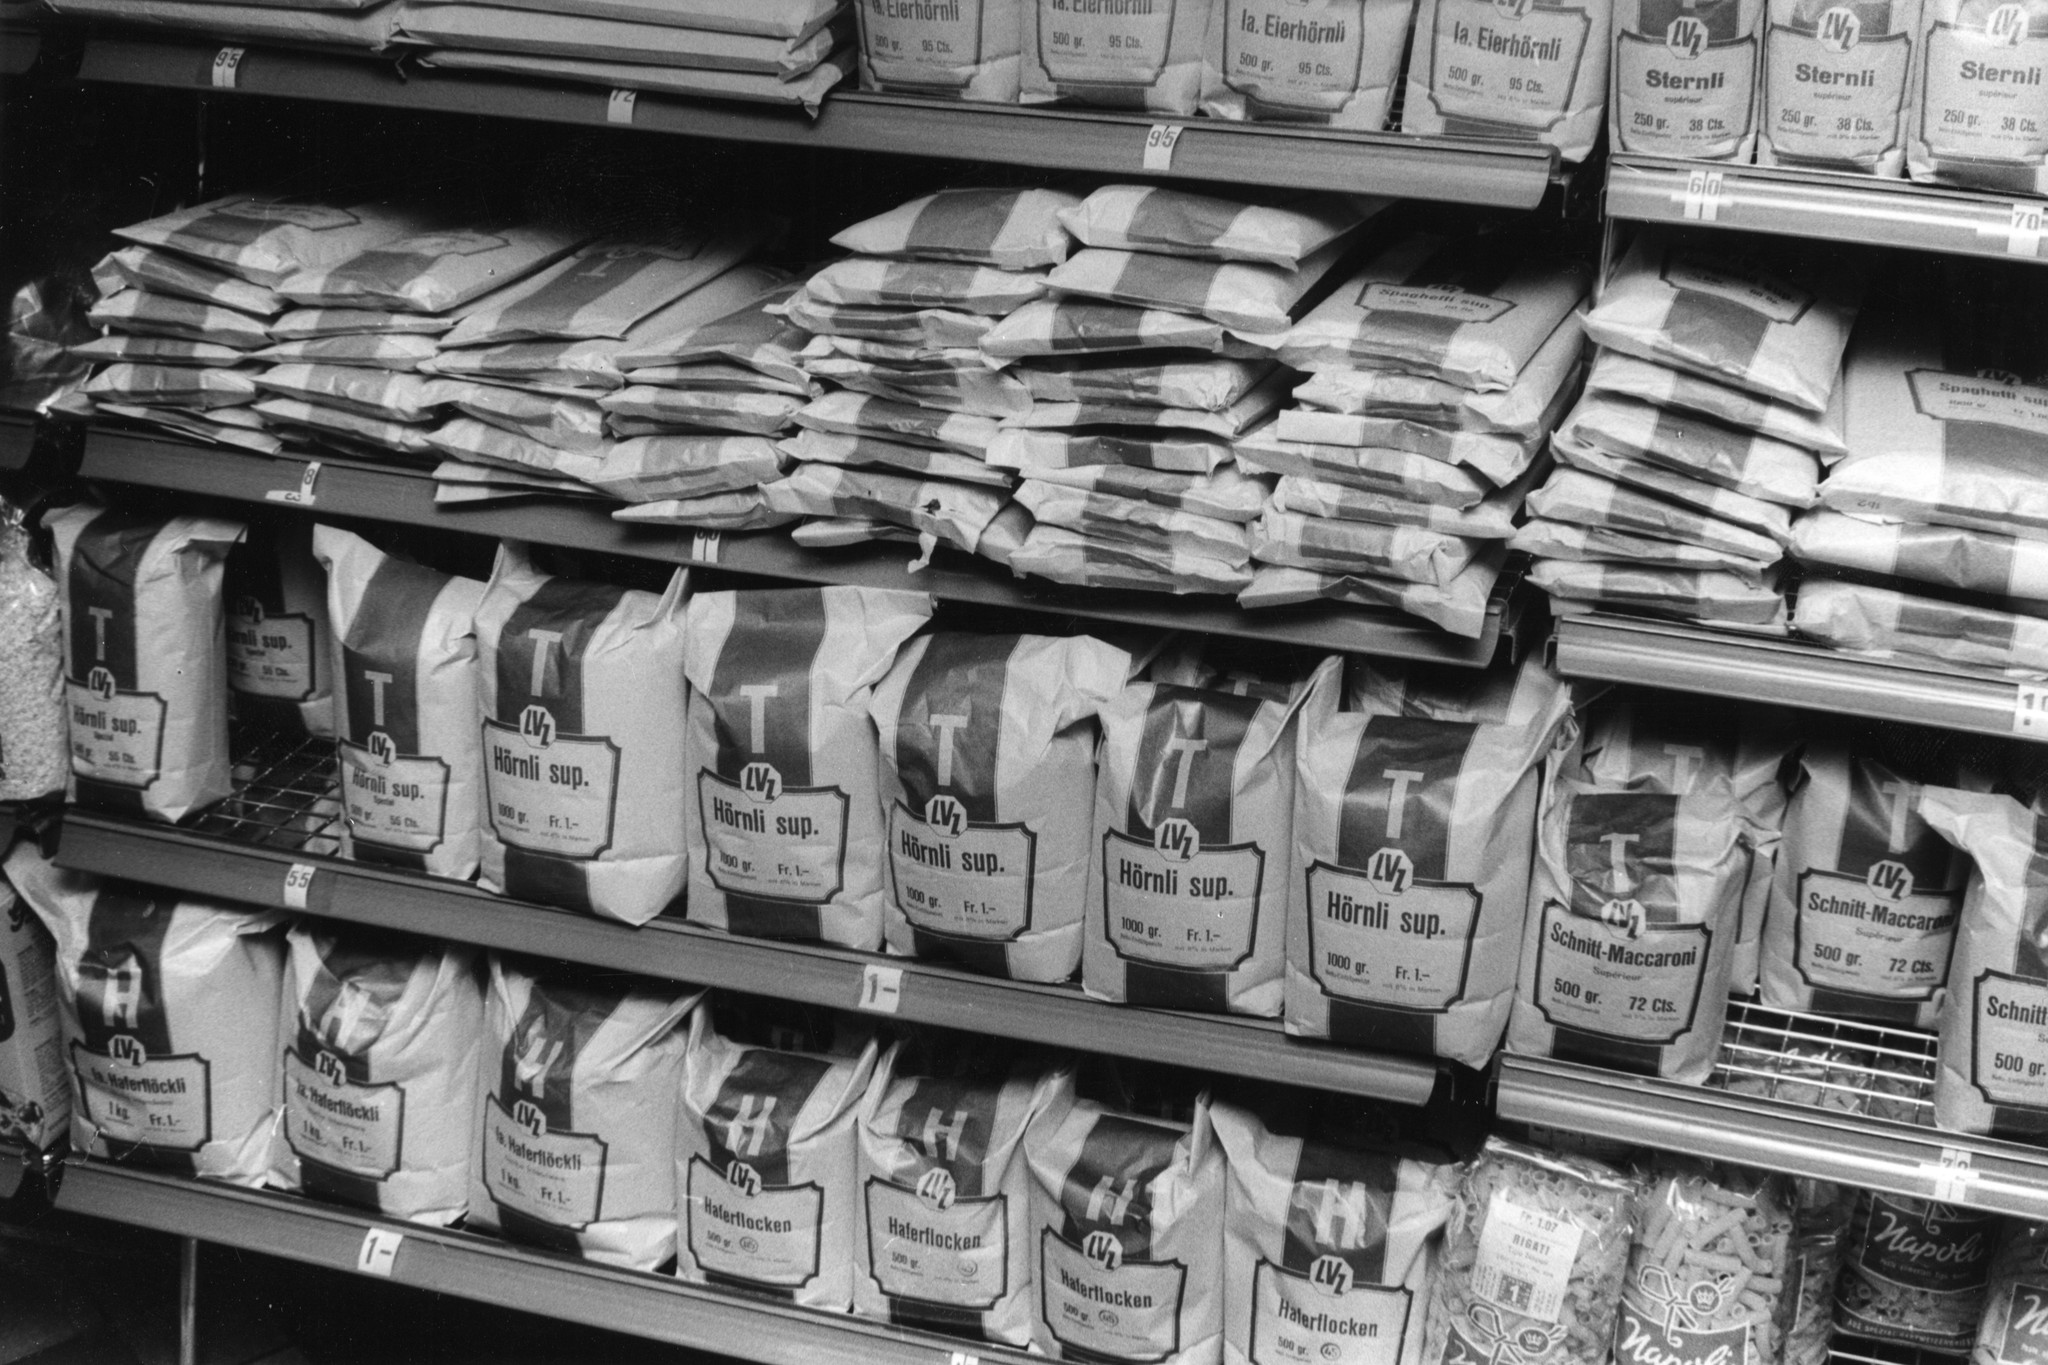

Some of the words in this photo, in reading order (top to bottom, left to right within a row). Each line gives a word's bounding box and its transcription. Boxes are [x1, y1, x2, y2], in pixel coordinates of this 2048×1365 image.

[922, 39, 933, 52] 95
[1053, 32, 1069, 45] 500
[1109, 35, 1121, 48] 95
[1125, 35, 1142, 48] Cts.
[1264, 14, 1346, 44] Eierhörnli
[1477, 26, 1562, 62] Eierhörnli
[215, 51, 240, 68] 95
[1240, 52, 1258, 68] 500
[1261, 57, 1274, 72] gr.
[1298, 61, 1312, 75] 95
[1315, 62, 1332, 77] Cts.
[1794, 62, 1875, 87] Sternli
[1959, 60, 2041, 86] Sternli
[1448, 66, 1468, 82] 500
[1470, 72, 1484, 87] gr.
[1508, 77, 1523, 91] 95
[1526, 78, 1544, 94] Cts.
[1645, 69, 1724, 90] Sternli
[1633, 111, 1653, 127] 250
[1656, 117, 1670, 132] gr.
[1689, 117, 1704, 133] 38
[1707, 117, 1725, 132] Cts.
[1781, 108, 1801, 124] 250
[1803, 112, 1817, 127] gr.
[1836, 116, 1852, 132] 38
[1855, 116, 1874, 132] Cts.
[1944, 108, 1964, 124] 250
[1966, 113, 1981, 127] gr.
[2001, 116, 2016, 132] 38
[2019, 116, 2038, 133] Cts.
[1149, 130, 1177, 148] 95
[1689, 176, 1719, 196] 60
[2014, 211, 2039, 230] 70
[1379, 288, 1456, 302] Spaghetti
[1939, 382, 2016, 400] Spaghetti
[88, 606, 113, 660] T
[262, 634, 292, 651] sup.
[528, 628, 563, 697] T
[364, 670, 393, 726] T
[73, 703, 106, 730] Hörnli
[111, 718, 142, 735] sup.
[524, 709, 550, 747] LVZ
[739, 685, 778, 754] T
[371, 734, 391, 766] LVZ
[929, 713, 968, 786] T
[494, 745, 540, 781] Hörnli
[550, 763, 590, 788] sup.
[1166, 738, 1208, 809] T
[352, 767, 386, 795] Hörnli
[392, 782, 424, 800] sup.
[745, 766, 776, 801] LVZ
[517, 810, 529, 825] gr.
[549, 815, 562, 829] Fr.
[713, 796, 765, 833] Hörnli
[777, 814, 819, 840] sup.
[931, 799, 961, 836] LVZ
[1382, 769, 1424, 839] T
[1882, 781, 1919, 852] T
[901, 829, 951, 869] Hörnli
[961, 848, 1005, 877] sup.
[1160, 823, 1193, 860] LVZ
[287, 870, 311, 888] 55
[719, 852, 738, 868] 1000
[741, 859, 755, 872] gr.
[778, 862, 792, 876] Fr.
[1372, 852, 1406, 893] LVZ
[1600, 832, 1640, 893] T
[1119, 858, 1178, 896] Hörnli
[1189, 874, 1234, 901] sup.
[1871, 863, 1907, 900] LVZ
[906, 885, 926, 905] 1000
[928, 896, 942, 910] gr.
[963, 900, 979, 914] Fr.
[1327, 890, 1389, 931] Hörnli
[1399, 910, 1446, 940] sup.
[1121, 917, 1144, 935] 1000
[1147, 924, 1162, 939] gr.
[1187, 928, 1202, 943] Fr.
[1550, 921, 1697, 969] Schnitt-Maccaroni
[1326, 952, 1351, 970] 1000
[1354, 959, 1370, 975] gr.
[1395, 965, 1411, 980] Fr.
[1814, 943, 1841, 961] 500
[1845, 952, 1863, 968] gr.
[1888, 958, 1905, 973] 72
[1911, 959, 1935, 974] Cts.
[1554, 977, 1581, 999] 500
[1584, 988, 1602, 1005] gr.
[1628, 996, 1647, 1011] 72
[1651, 997, 1677, 1013] Cts.
[109, 1068, 186, 1095] Haferflöckli
[1994, 1053, 2024, 1072] 500
[2028, 1059, 2046, 1077] gr.
[149, 1113, 163, 1127] Fr.
[310, 1088, 379, 1122] Haferflöckli
[518, 1103, 541, 1137] LVZ
[725, 1094, 778, 1156] H
[923, 1106, 968, 1162] H
[342, 1136, 355, 1150] Fr.
[508, 1133, 582, 1172] Haferflöckli
[540, 1187, 555, 1203] Fr.
[730, 1161, 756, 1197] LVZ
[704, 1195, 792, 1233] Haferflocken
[1315, 1178, 1366, 1249] H
[888, 1215, 981, 1251] Haferflocken
[1512, 1234, 1550, 1256] RIGATI
[1873, 1210, 1983, 1264] Napoli
[891, 1252, 908, 1266] 500
[1087, 1234, 1115, 1271] LVZ
[1061, 1267, 1153, 1309] Haferflocken
[1315, 1259, 1346, 1295] LVZ
[1510, 1285, 1519, 1302] 1
[1063, 1302, 1080, 1317] 500
[1278, 1297, 1378, 1337] Haferflocken
[1277, 1335, 1295, 1352] 500
